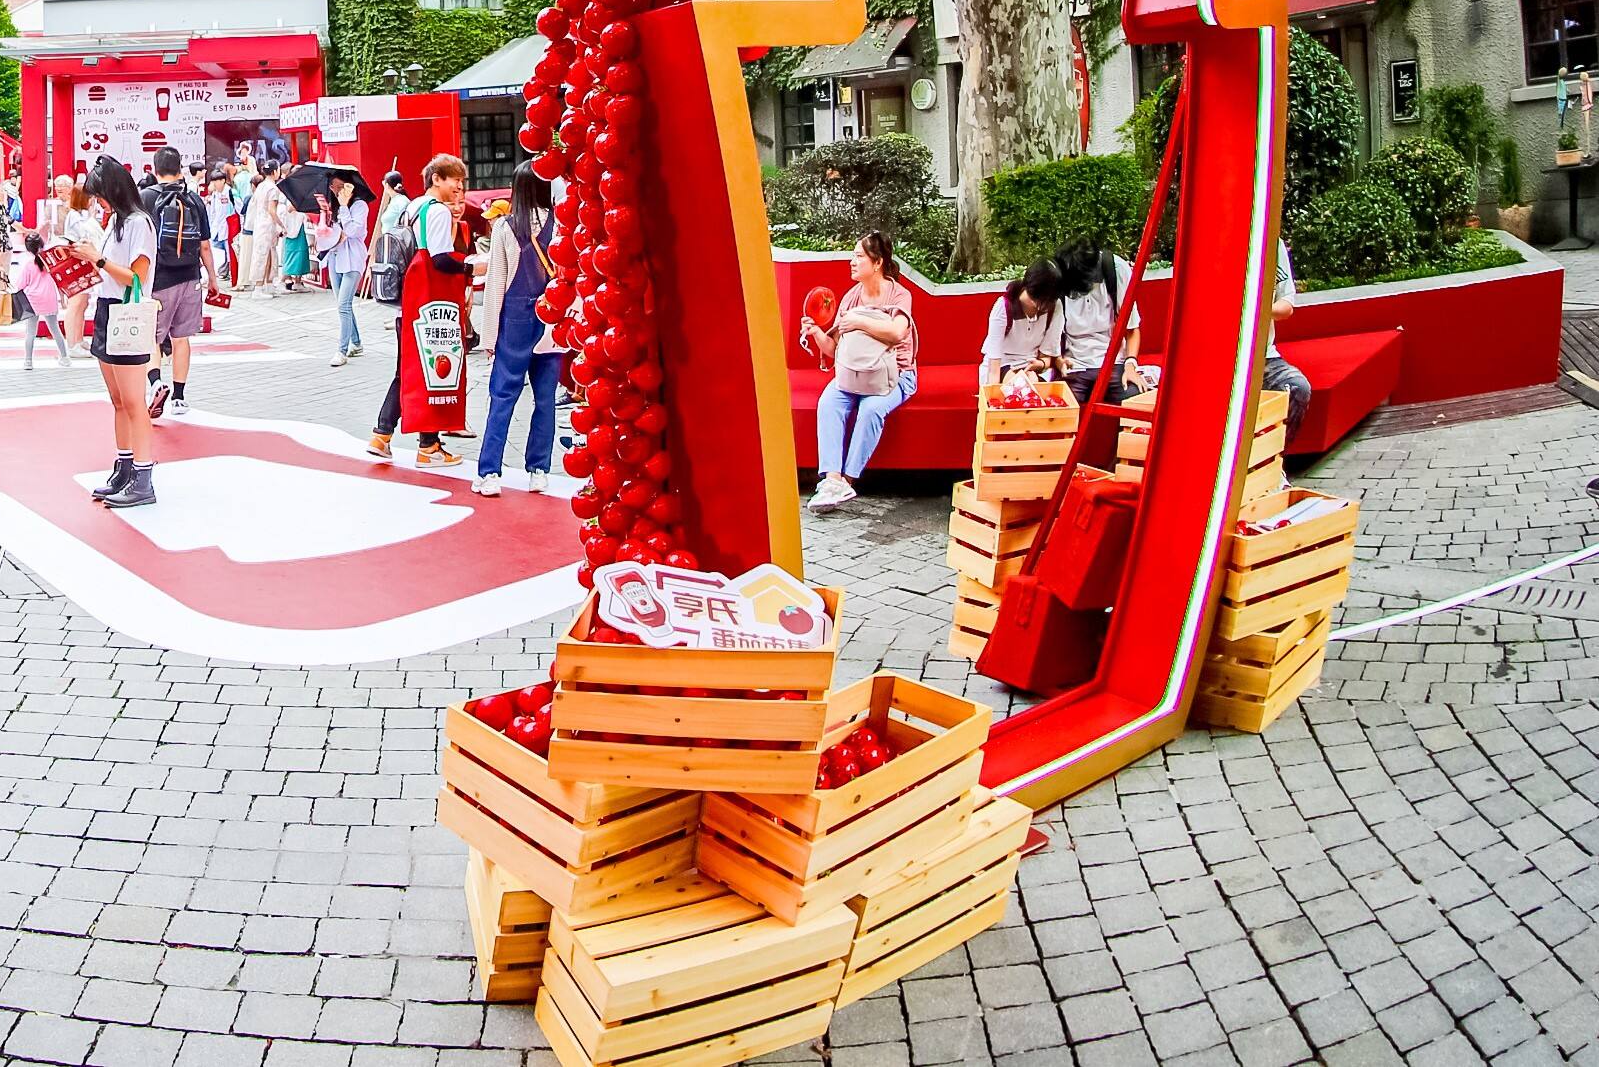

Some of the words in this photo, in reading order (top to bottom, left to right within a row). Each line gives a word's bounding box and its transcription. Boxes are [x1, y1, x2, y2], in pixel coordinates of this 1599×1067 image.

[175, 90, 212, 103] HEINZ
[95, 107, 115, 115] 1869
[237, 103, 257, 111] 1869
[115, 122, 140, 132] HEINZ
[672, 591, 739, 626] 亨氏
